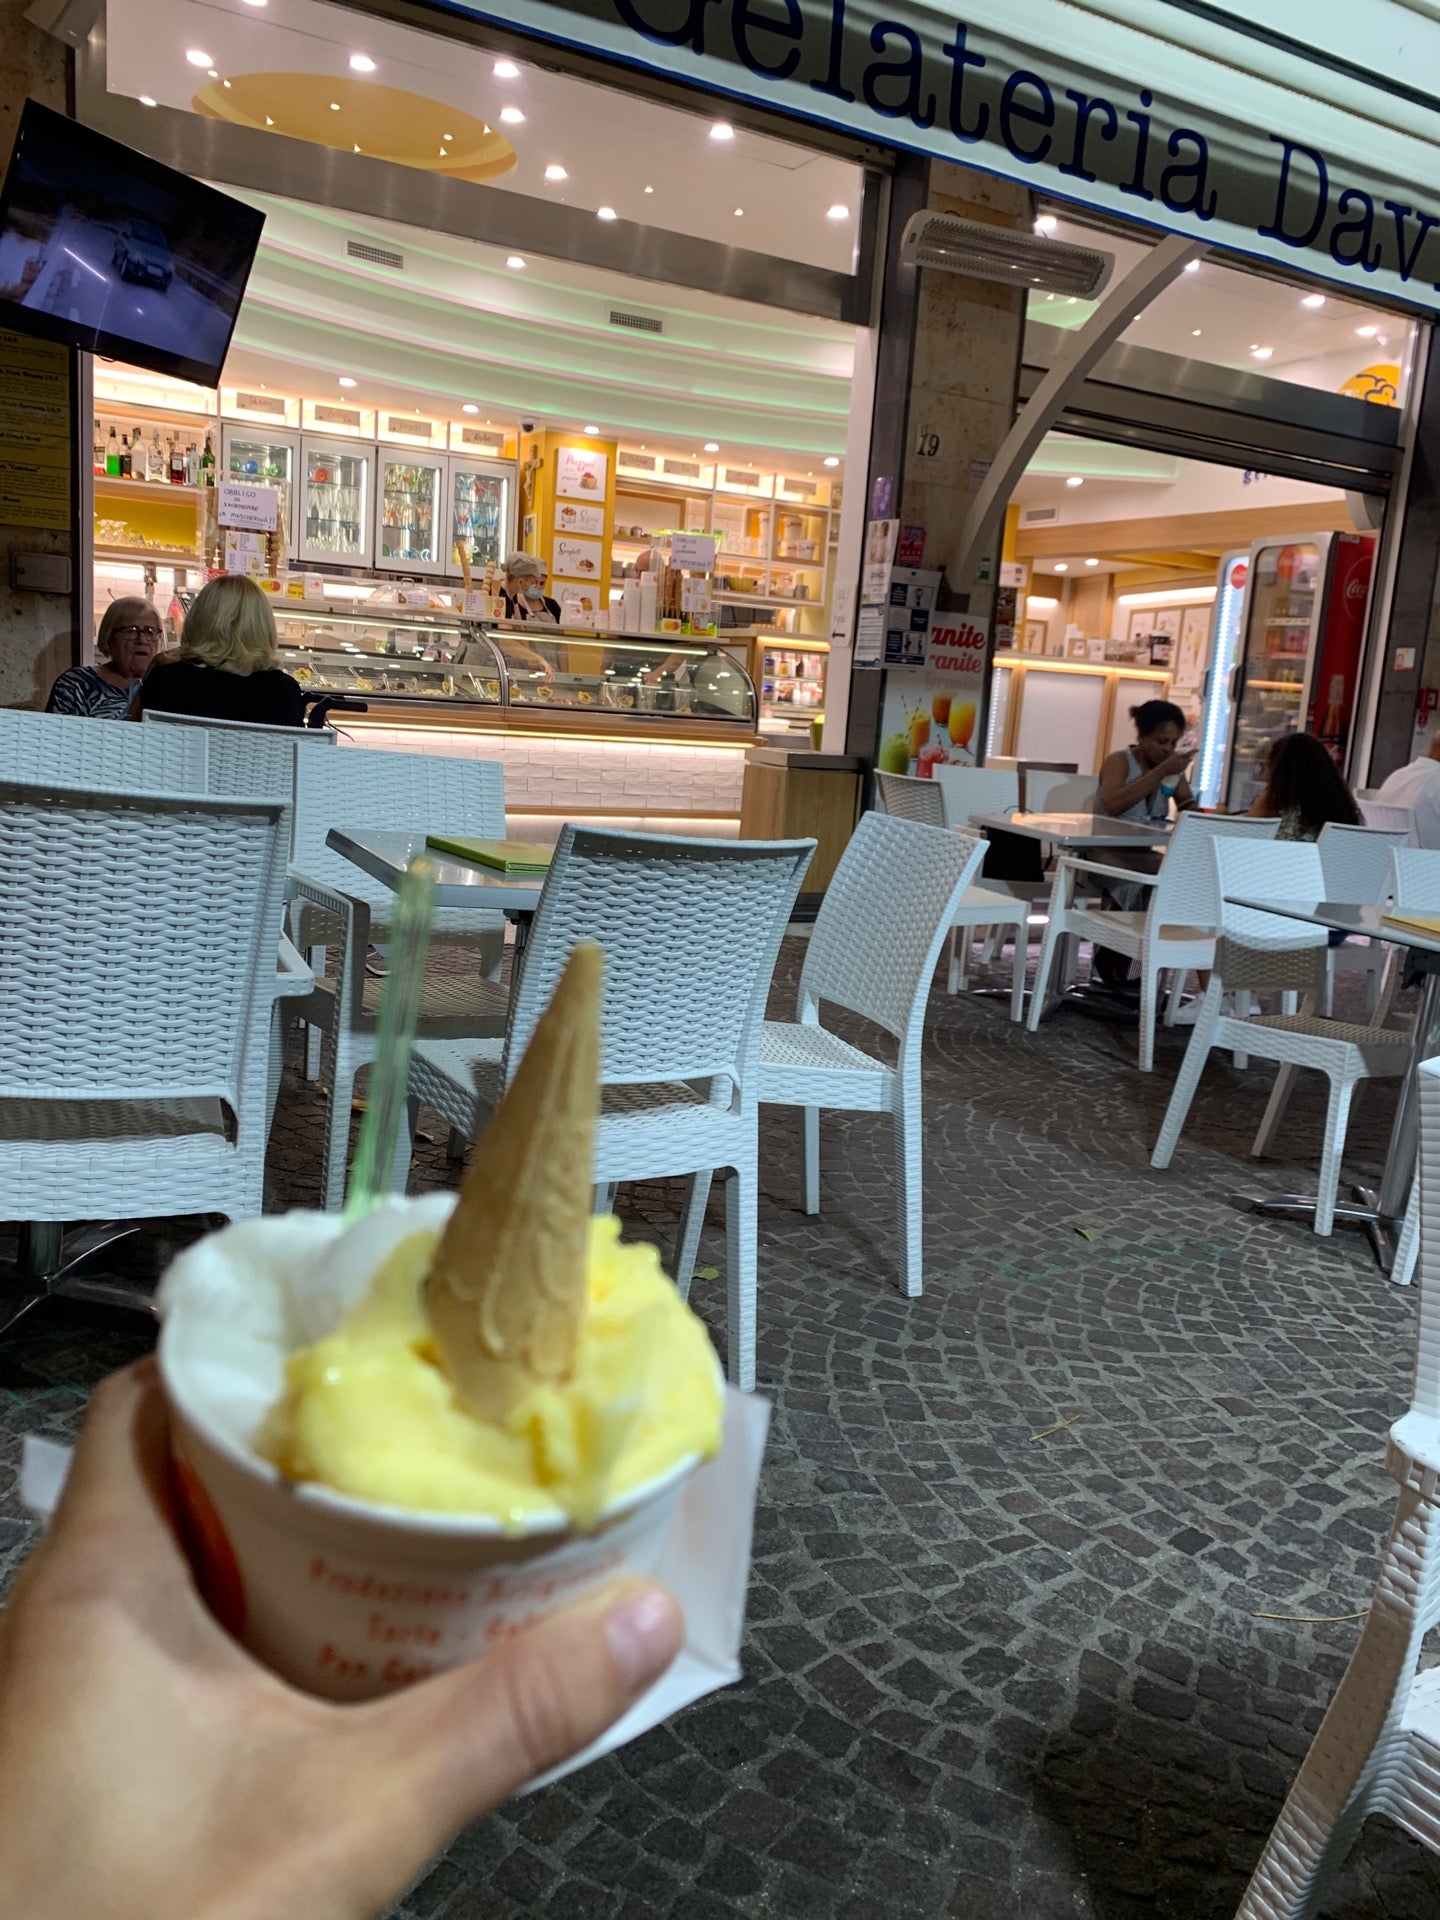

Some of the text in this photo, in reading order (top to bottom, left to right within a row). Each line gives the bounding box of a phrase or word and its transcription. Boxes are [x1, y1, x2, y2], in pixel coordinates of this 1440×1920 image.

[1257, 133, 1440, 292] Dav
[917, 433, 940, 457] 19
[223, 488, 257, 498] OBBLIGO
[932, 622, 986, 650] anite
[930, 652, 983, 673] anite
